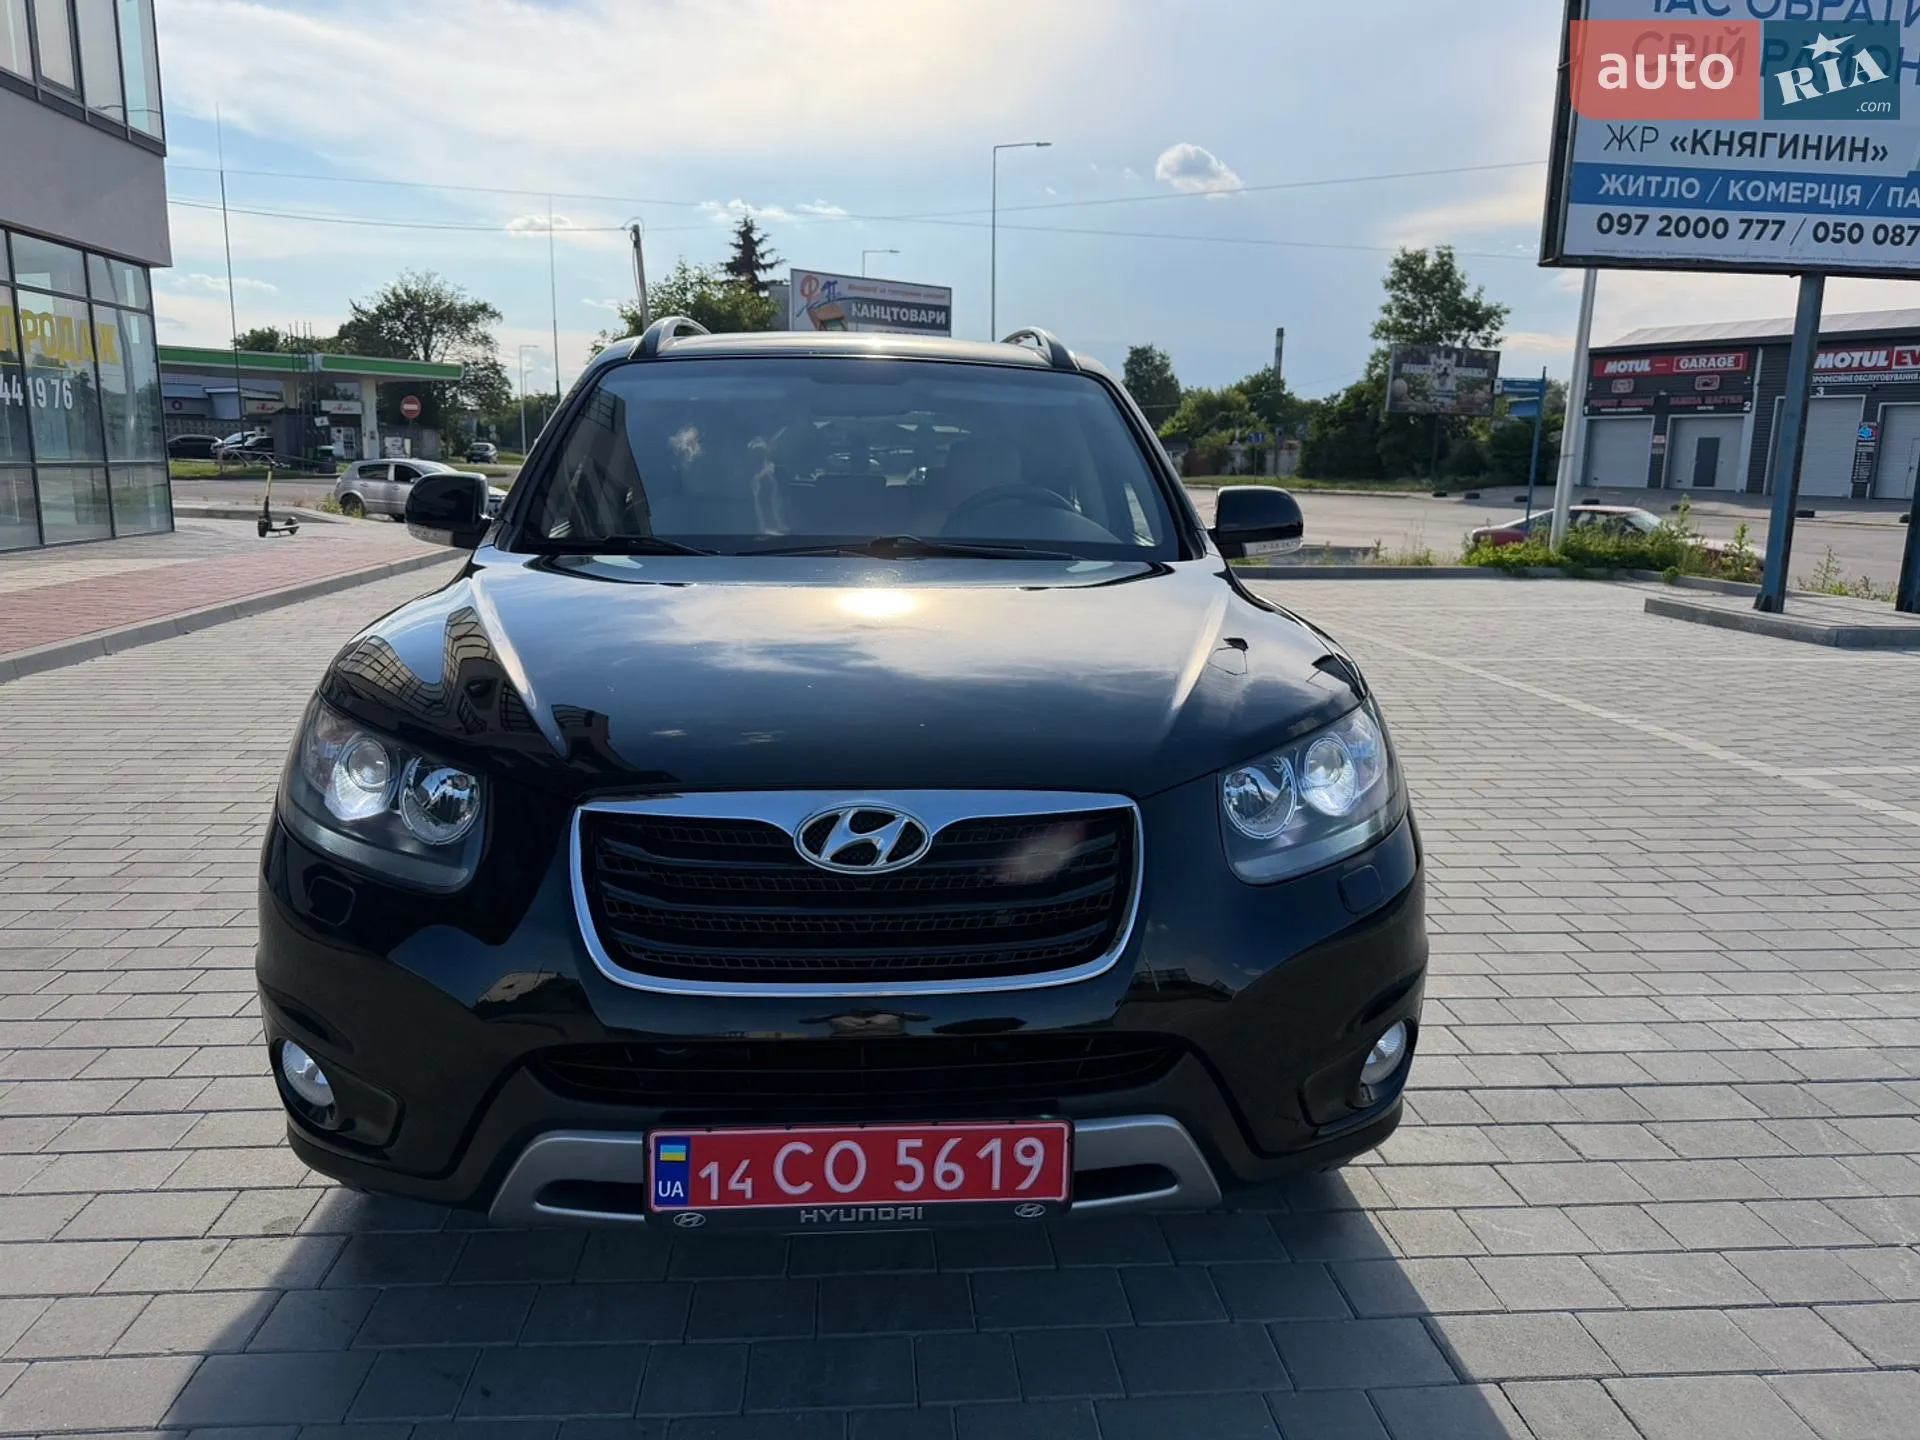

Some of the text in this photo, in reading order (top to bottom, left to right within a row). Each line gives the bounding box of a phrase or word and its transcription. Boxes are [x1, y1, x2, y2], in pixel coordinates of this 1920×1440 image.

[1603, 123, 1888, 163] ЖР «КНЯГИНИН»
[1598, 173, 1701, 199] ЖИТЛО
[1727, 179, 1862, 209] КОМЕРЦІЯ
[1596, 212, 1650, 236] 097
[1656, 214, 1729, 240] 2000
[1738, 218, 1786, 241] 777
[1812, 221, 1864, 245] 050
[1872, 223, 1920, 247] 087
[851, 302, 946, 325] КАНЦТОВАРИ
[0, 305, 121, 367] ПРОДАЖ
[1604, 355, 1735, 373] MOTUL GARAGE
[1813, 350, 1889, 369] MOTUL
[27, 377, 47, 408] 19
[51, 378, 73, 409] 76
[1816, 386, 1825, 397] 3
[1743, 401, 1752, 411] 2
[658, 1180, 684, 1198] UA
[698, 1158, 753, 1201] 14
[893, 1136, 1046, 1193] 5619
[800, 1206, 923, 1224] HYUNDAI
